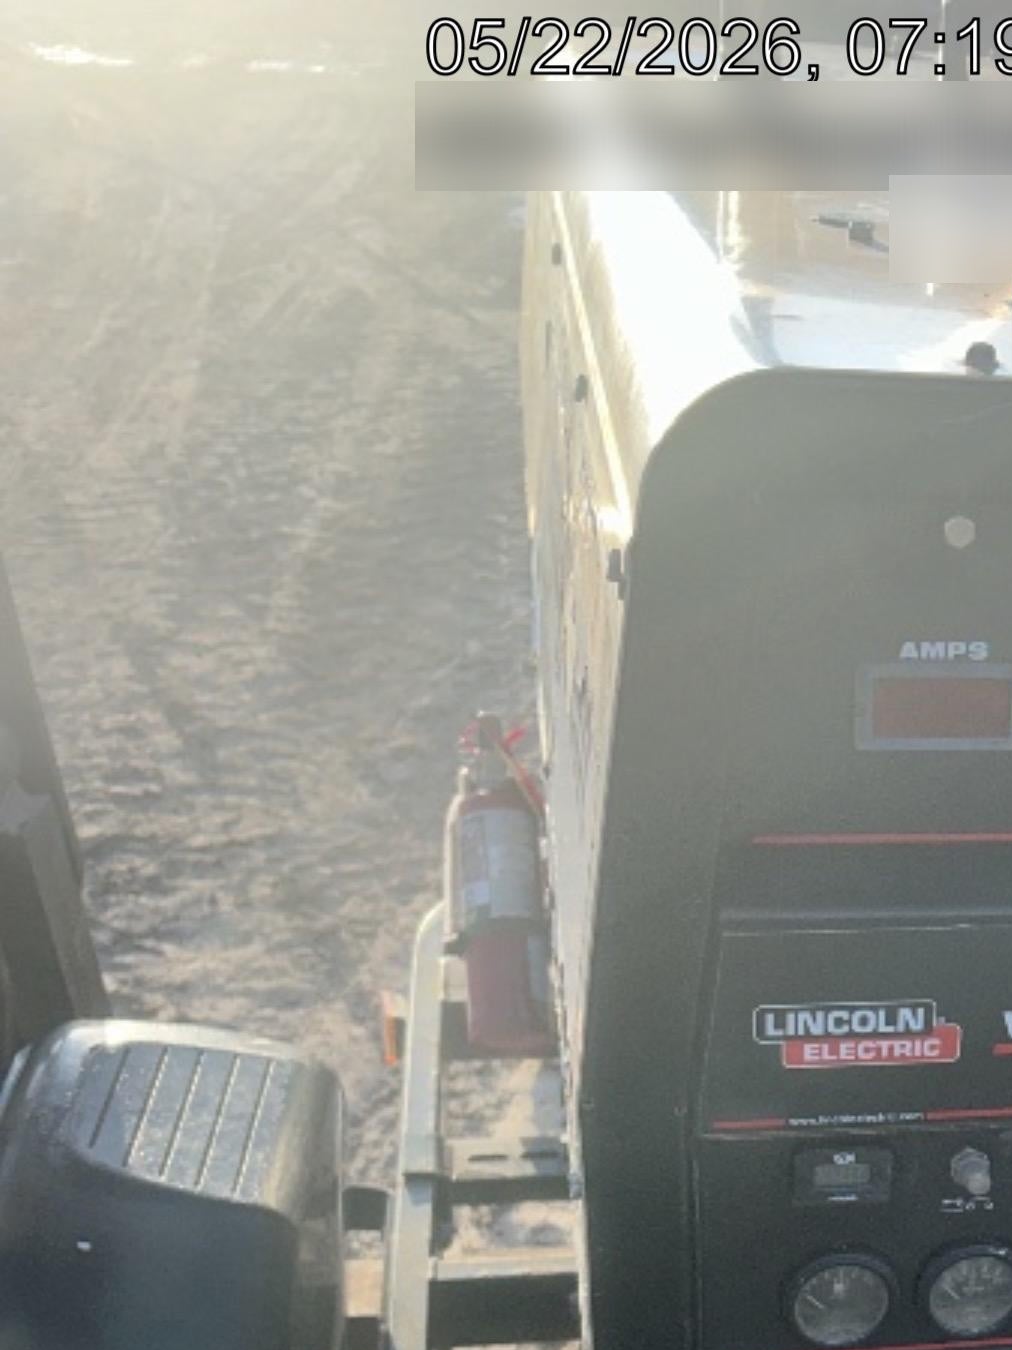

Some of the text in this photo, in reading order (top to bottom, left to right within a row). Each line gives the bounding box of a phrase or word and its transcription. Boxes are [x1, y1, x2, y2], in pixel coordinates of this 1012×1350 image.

[899, 641, 990, 661] AMPS
[765, 1007, 925, 1036] LINCOLN
[803, 1038, 942, 1061] ELECTRIC
